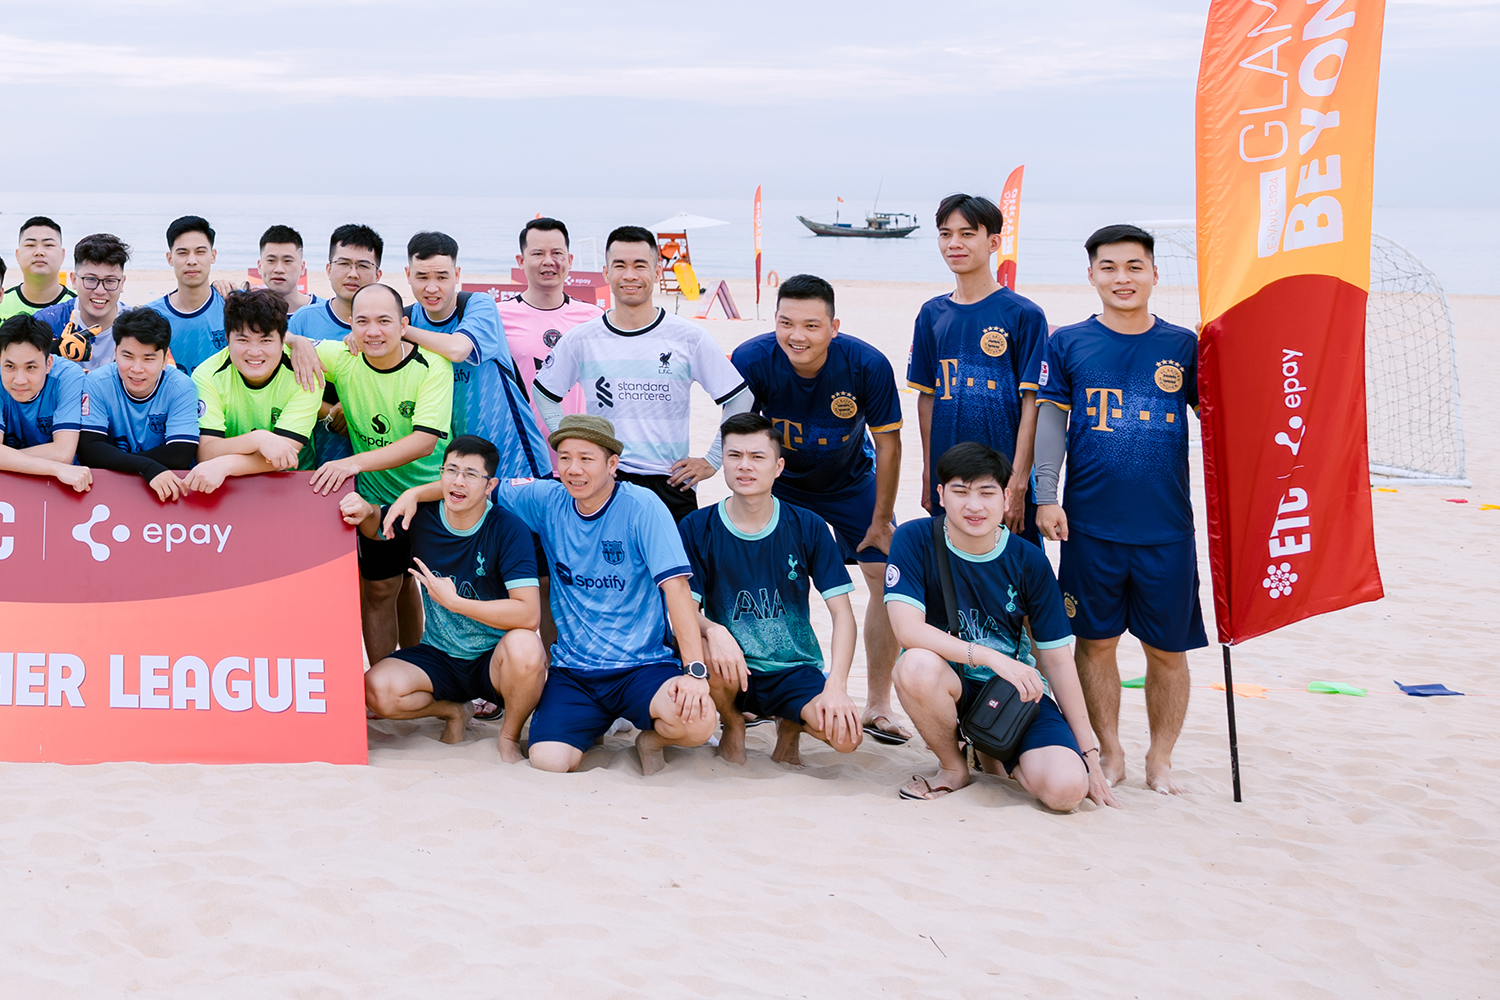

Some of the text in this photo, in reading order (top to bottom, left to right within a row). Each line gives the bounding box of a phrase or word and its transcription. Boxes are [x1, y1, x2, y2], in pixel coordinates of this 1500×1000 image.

[1267, 177, 1279, 250] E-Vivu 2024
[617, 381, 670, 392] standard
[618, 391, 672, 402] chartered
[1282, 348, 1307, 408] epay
[141, 522, 233, 554] epay
[1268, 487, 1312, 558] ETC
[575, 574, 626, 592] Spotify
[109, 654, 328, 714] LEAGUE
